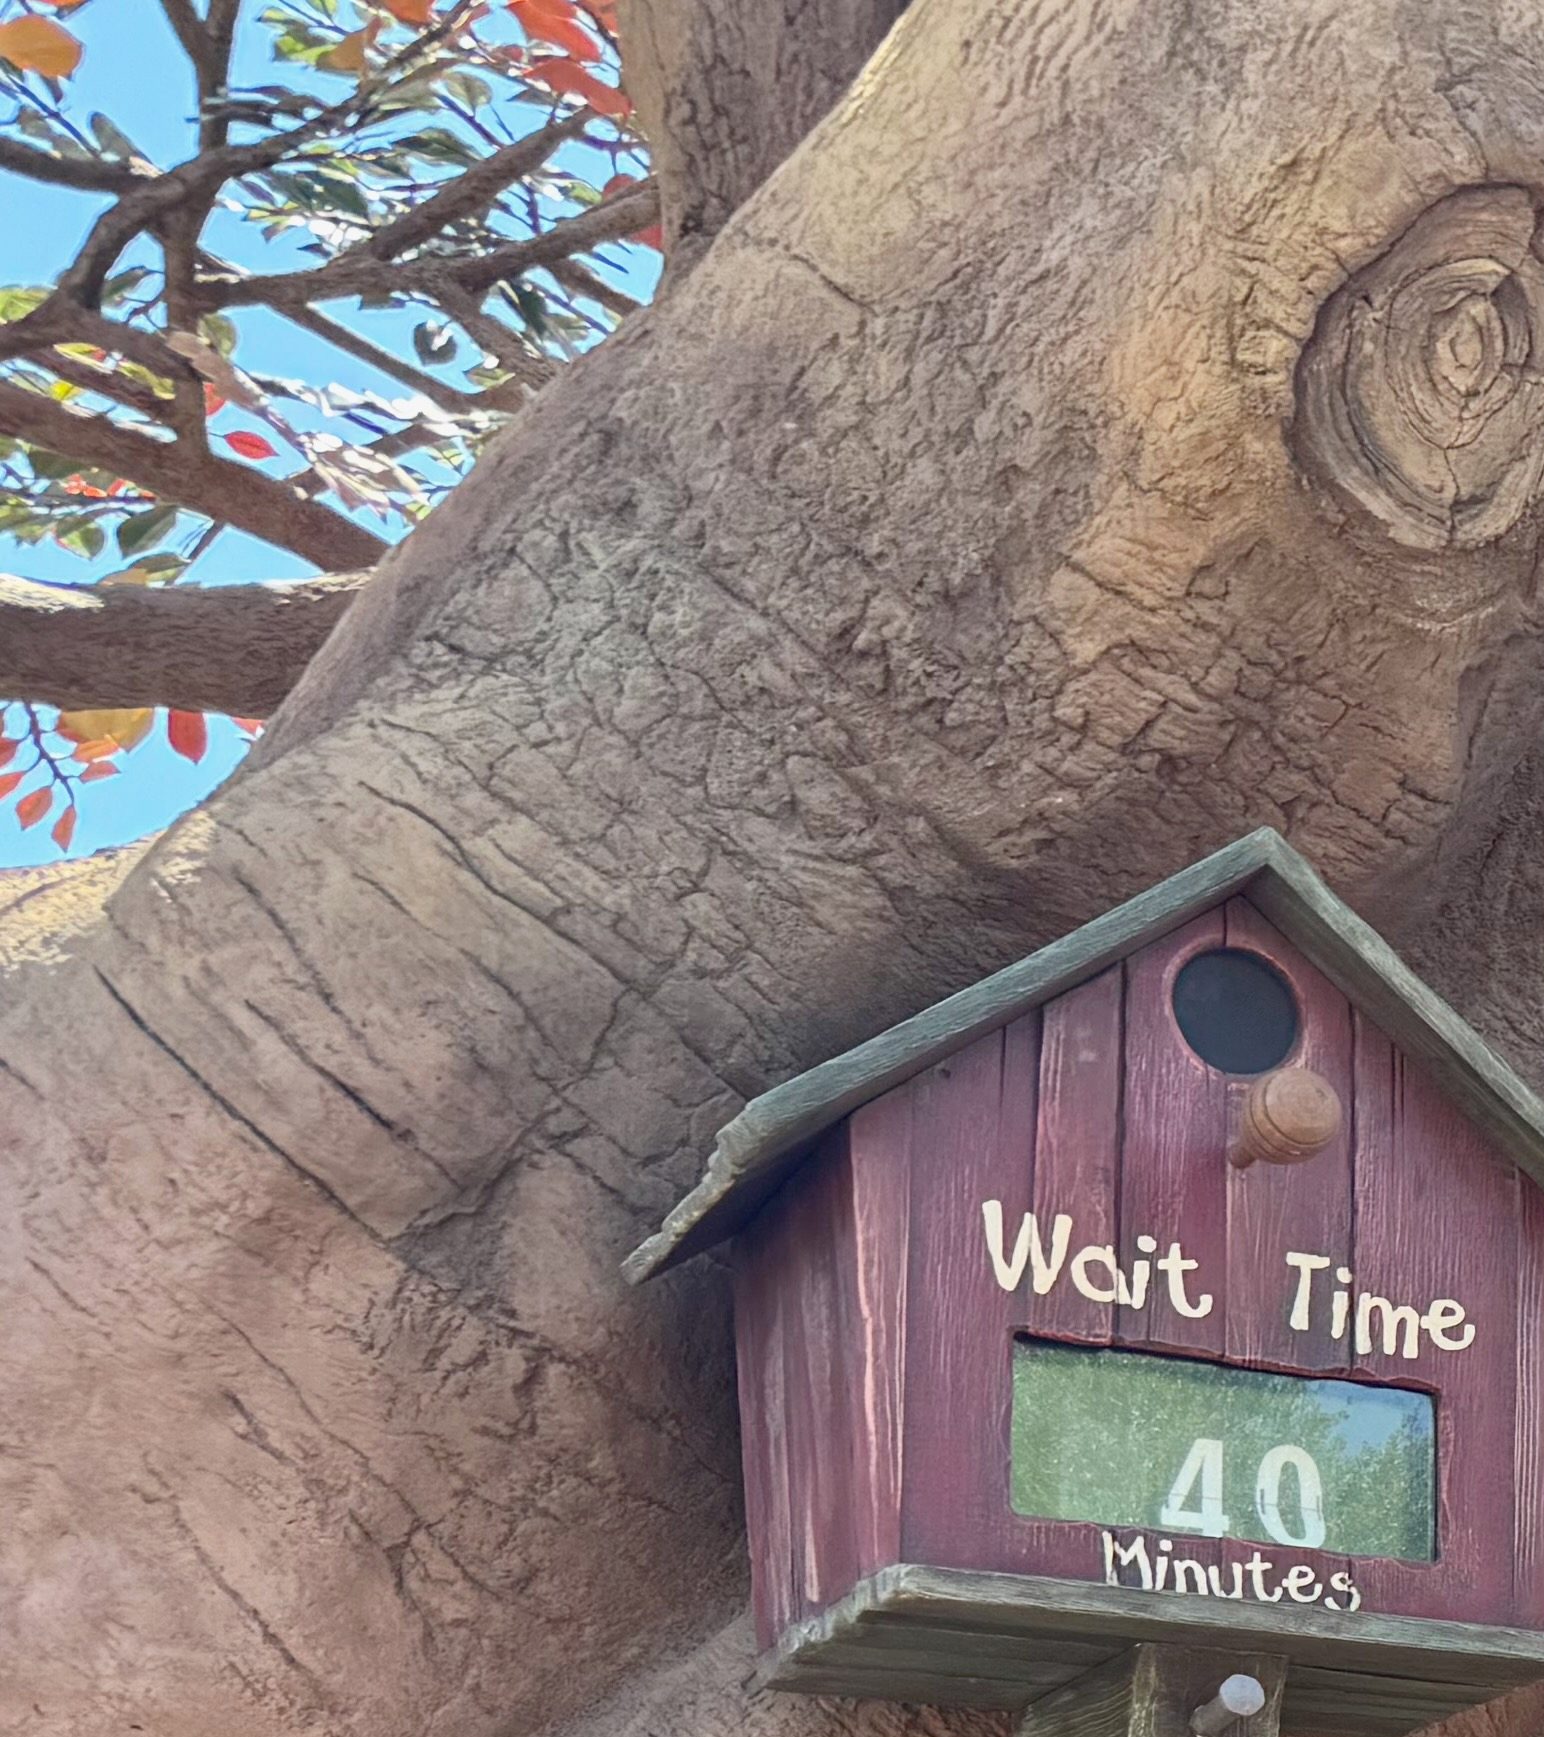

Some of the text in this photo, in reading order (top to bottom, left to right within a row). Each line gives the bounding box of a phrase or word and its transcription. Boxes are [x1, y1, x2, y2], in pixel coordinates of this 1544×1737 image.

[982, 1199, 1476, 1360] Wait Time
[1159, 1438, 1328, 1549] 40
[1102, 1530, 1363, 1613] Minutes
